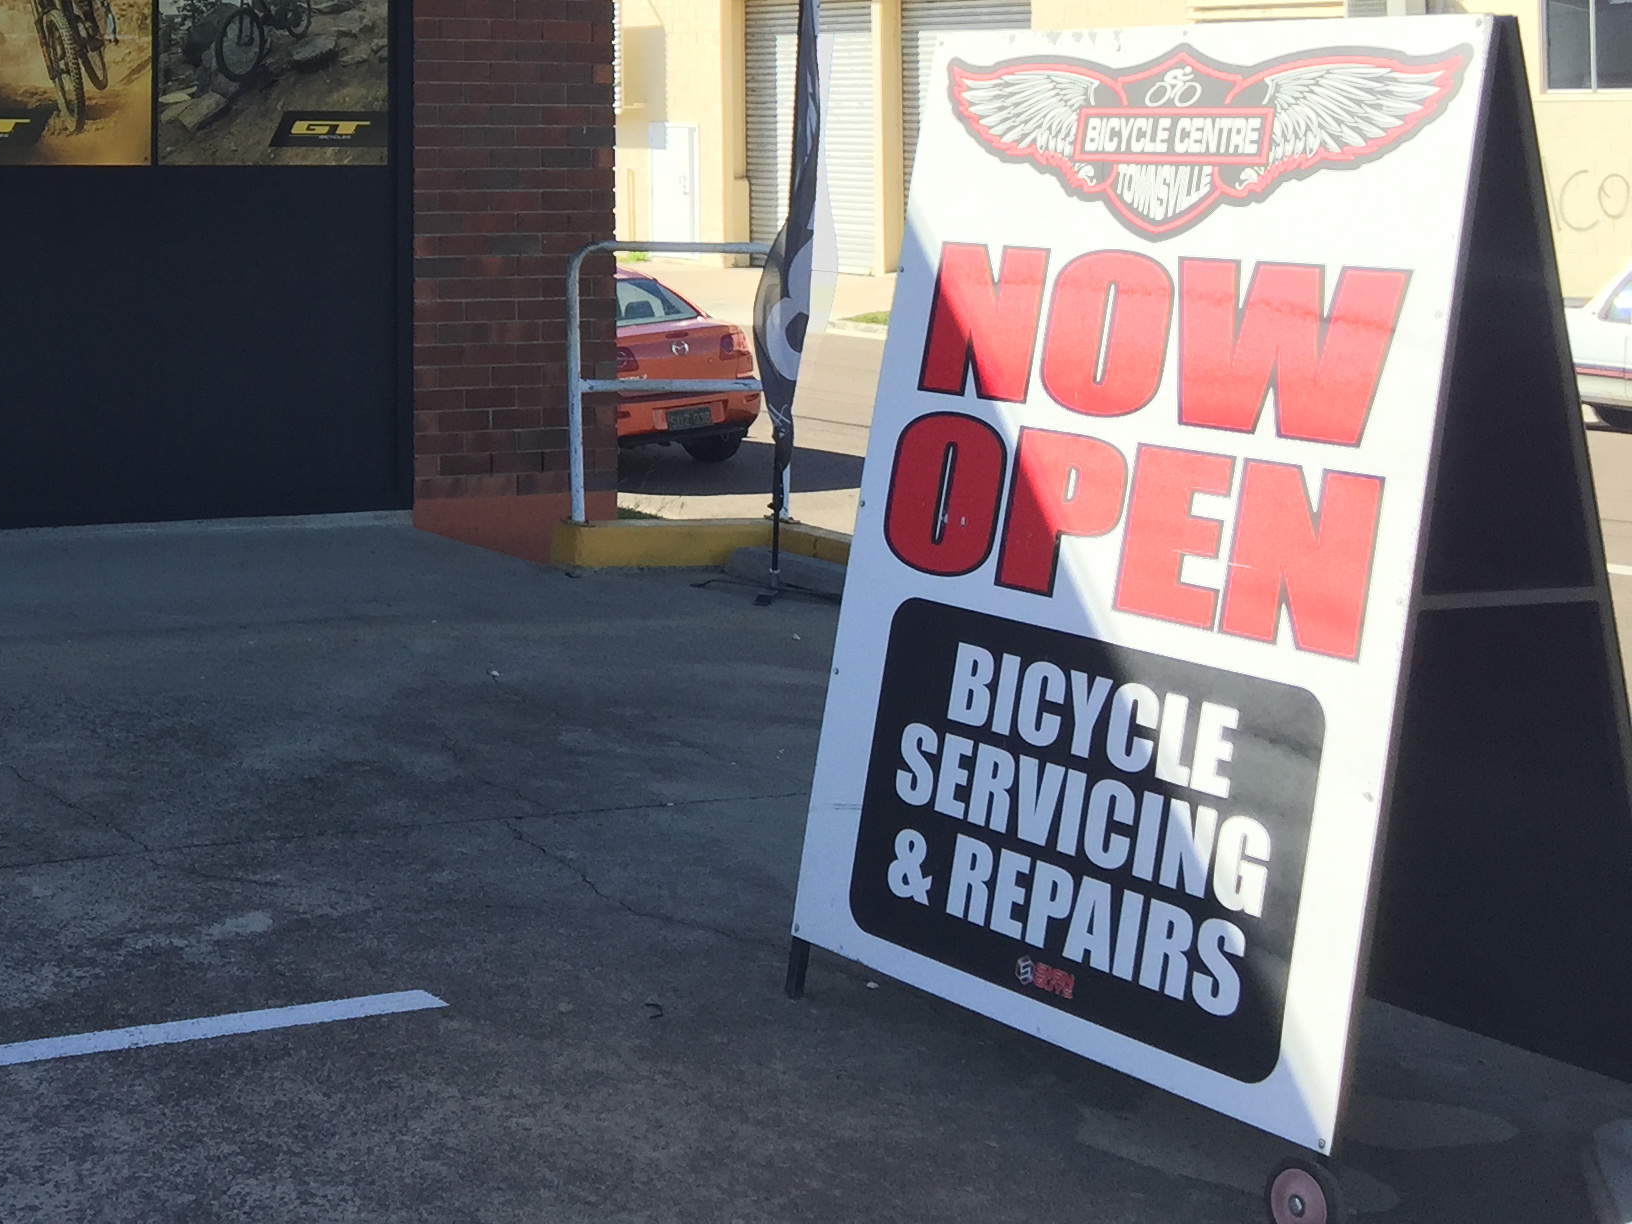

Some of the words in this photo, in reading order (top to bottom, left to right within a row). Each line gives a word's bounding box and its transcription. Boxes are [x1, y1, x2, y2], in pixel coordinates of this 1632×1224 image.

[291, 120, 371, 135] GT
[1085, 117, 1171, 152] BICYCLE
[1175, 117, 1262, 154] CENTRE
[1117, 163, 1213, 221] TOWNSVILLE
[917, 241, 1414, 448] NOW
[883, 411, 1386, 663] OPEN
[946, 641, 1240, 800] BICYCLE
[895, 722, 1272, 918] SERVICING
[886, 828, 933, 905] &
[946, 834, 1247, 1017] REPAIRS
